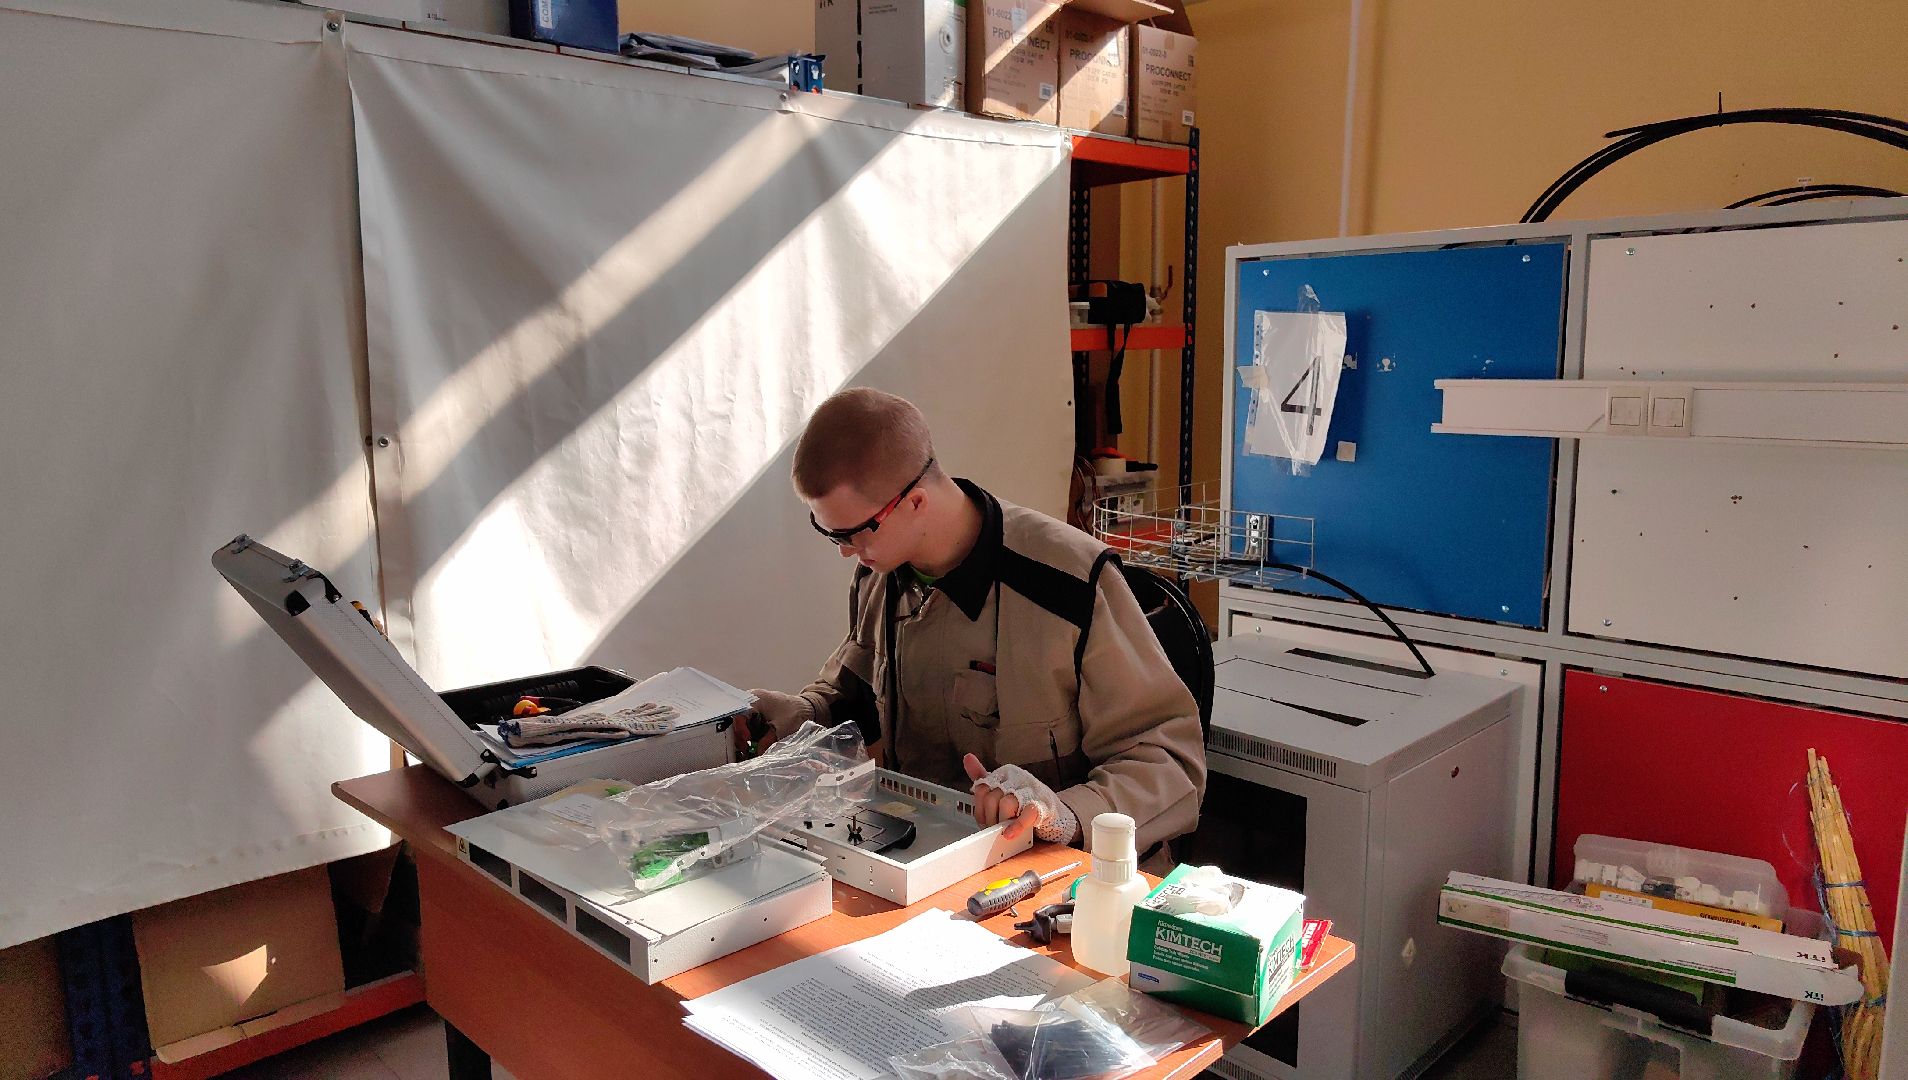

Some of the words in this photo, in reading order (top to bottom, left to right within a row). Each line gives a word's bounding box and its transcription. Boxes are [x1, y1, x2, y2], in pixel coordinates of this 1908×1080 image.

[1145, 63, 1192, 81] PROCONNECT
[1281, 355, 1322, 436] 4
[1155, 926, 1223, 956] KIMTECH
